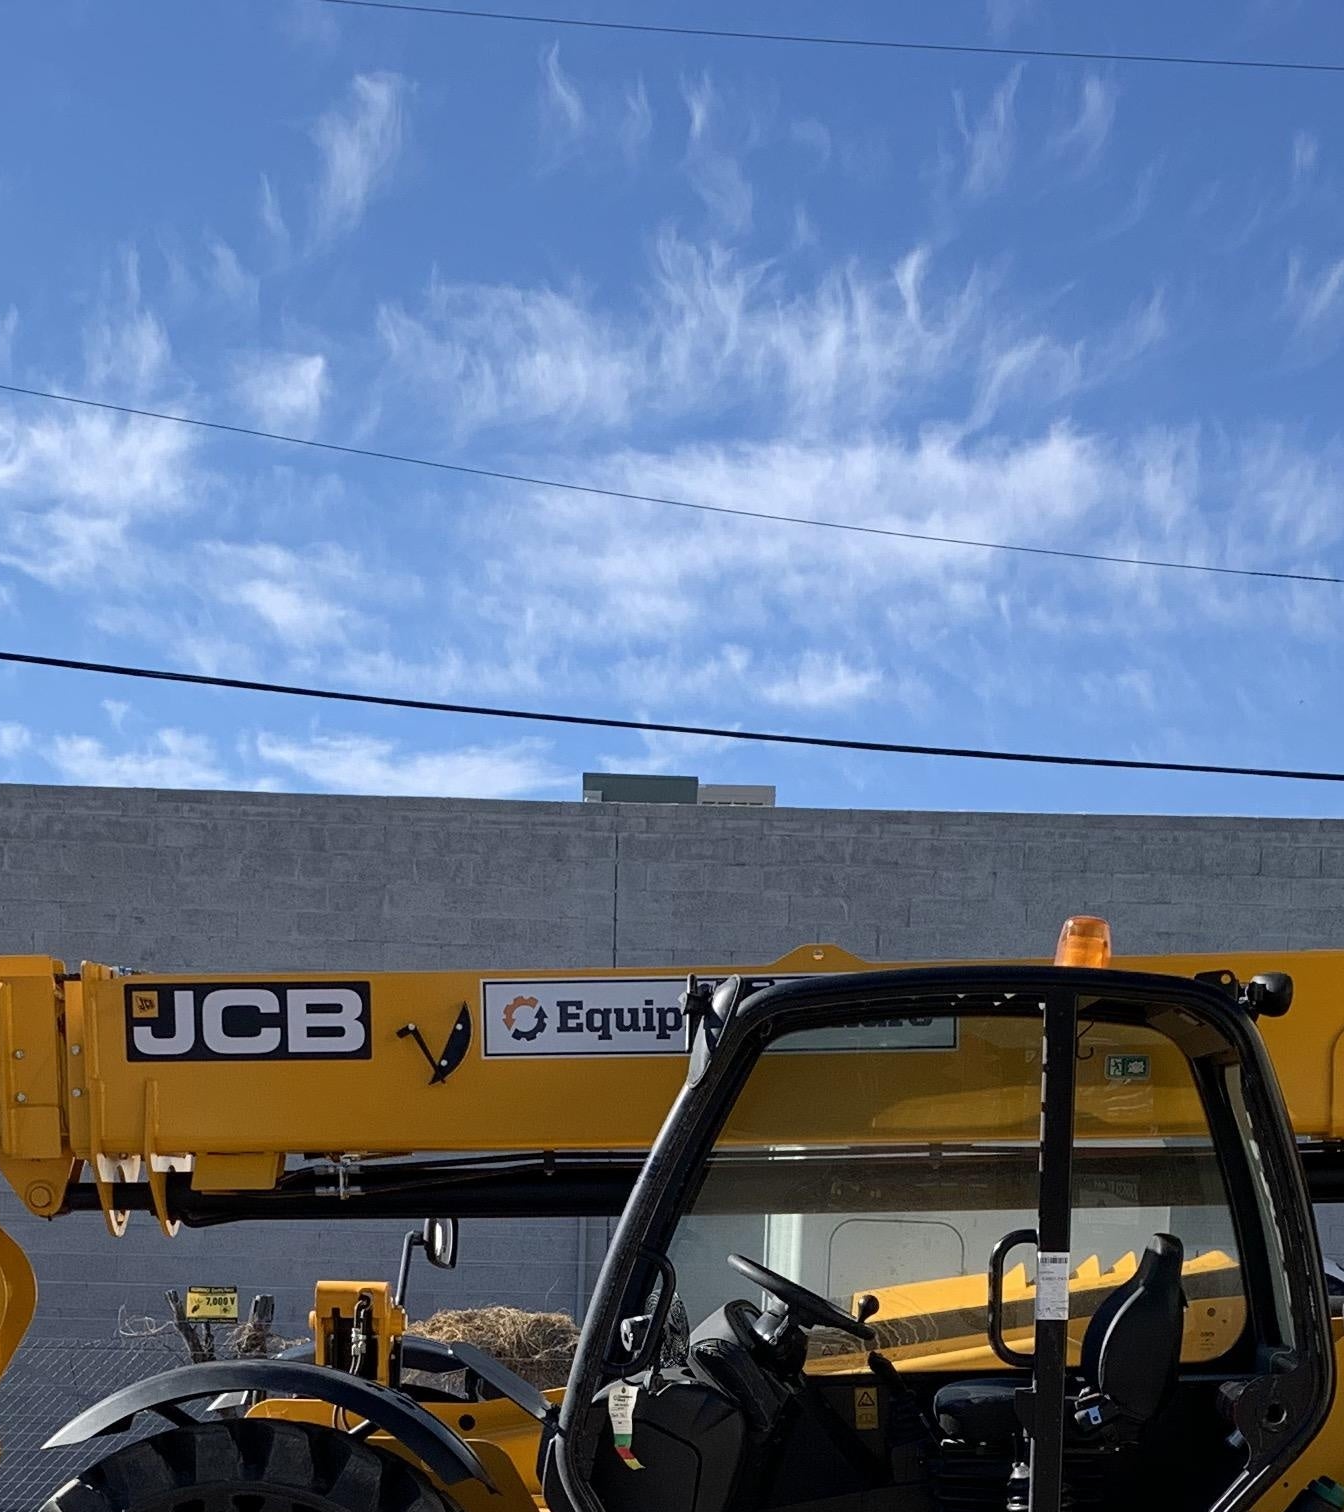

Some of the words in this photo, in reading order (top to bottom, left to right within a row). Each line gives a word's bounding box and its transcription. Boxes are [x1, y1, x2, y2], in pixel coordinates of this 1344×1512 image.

[133, 988, 366, 1055] JCB
[205, 1296, 229, 1307] 7,000
[230, 1296, 236, 1306] V
